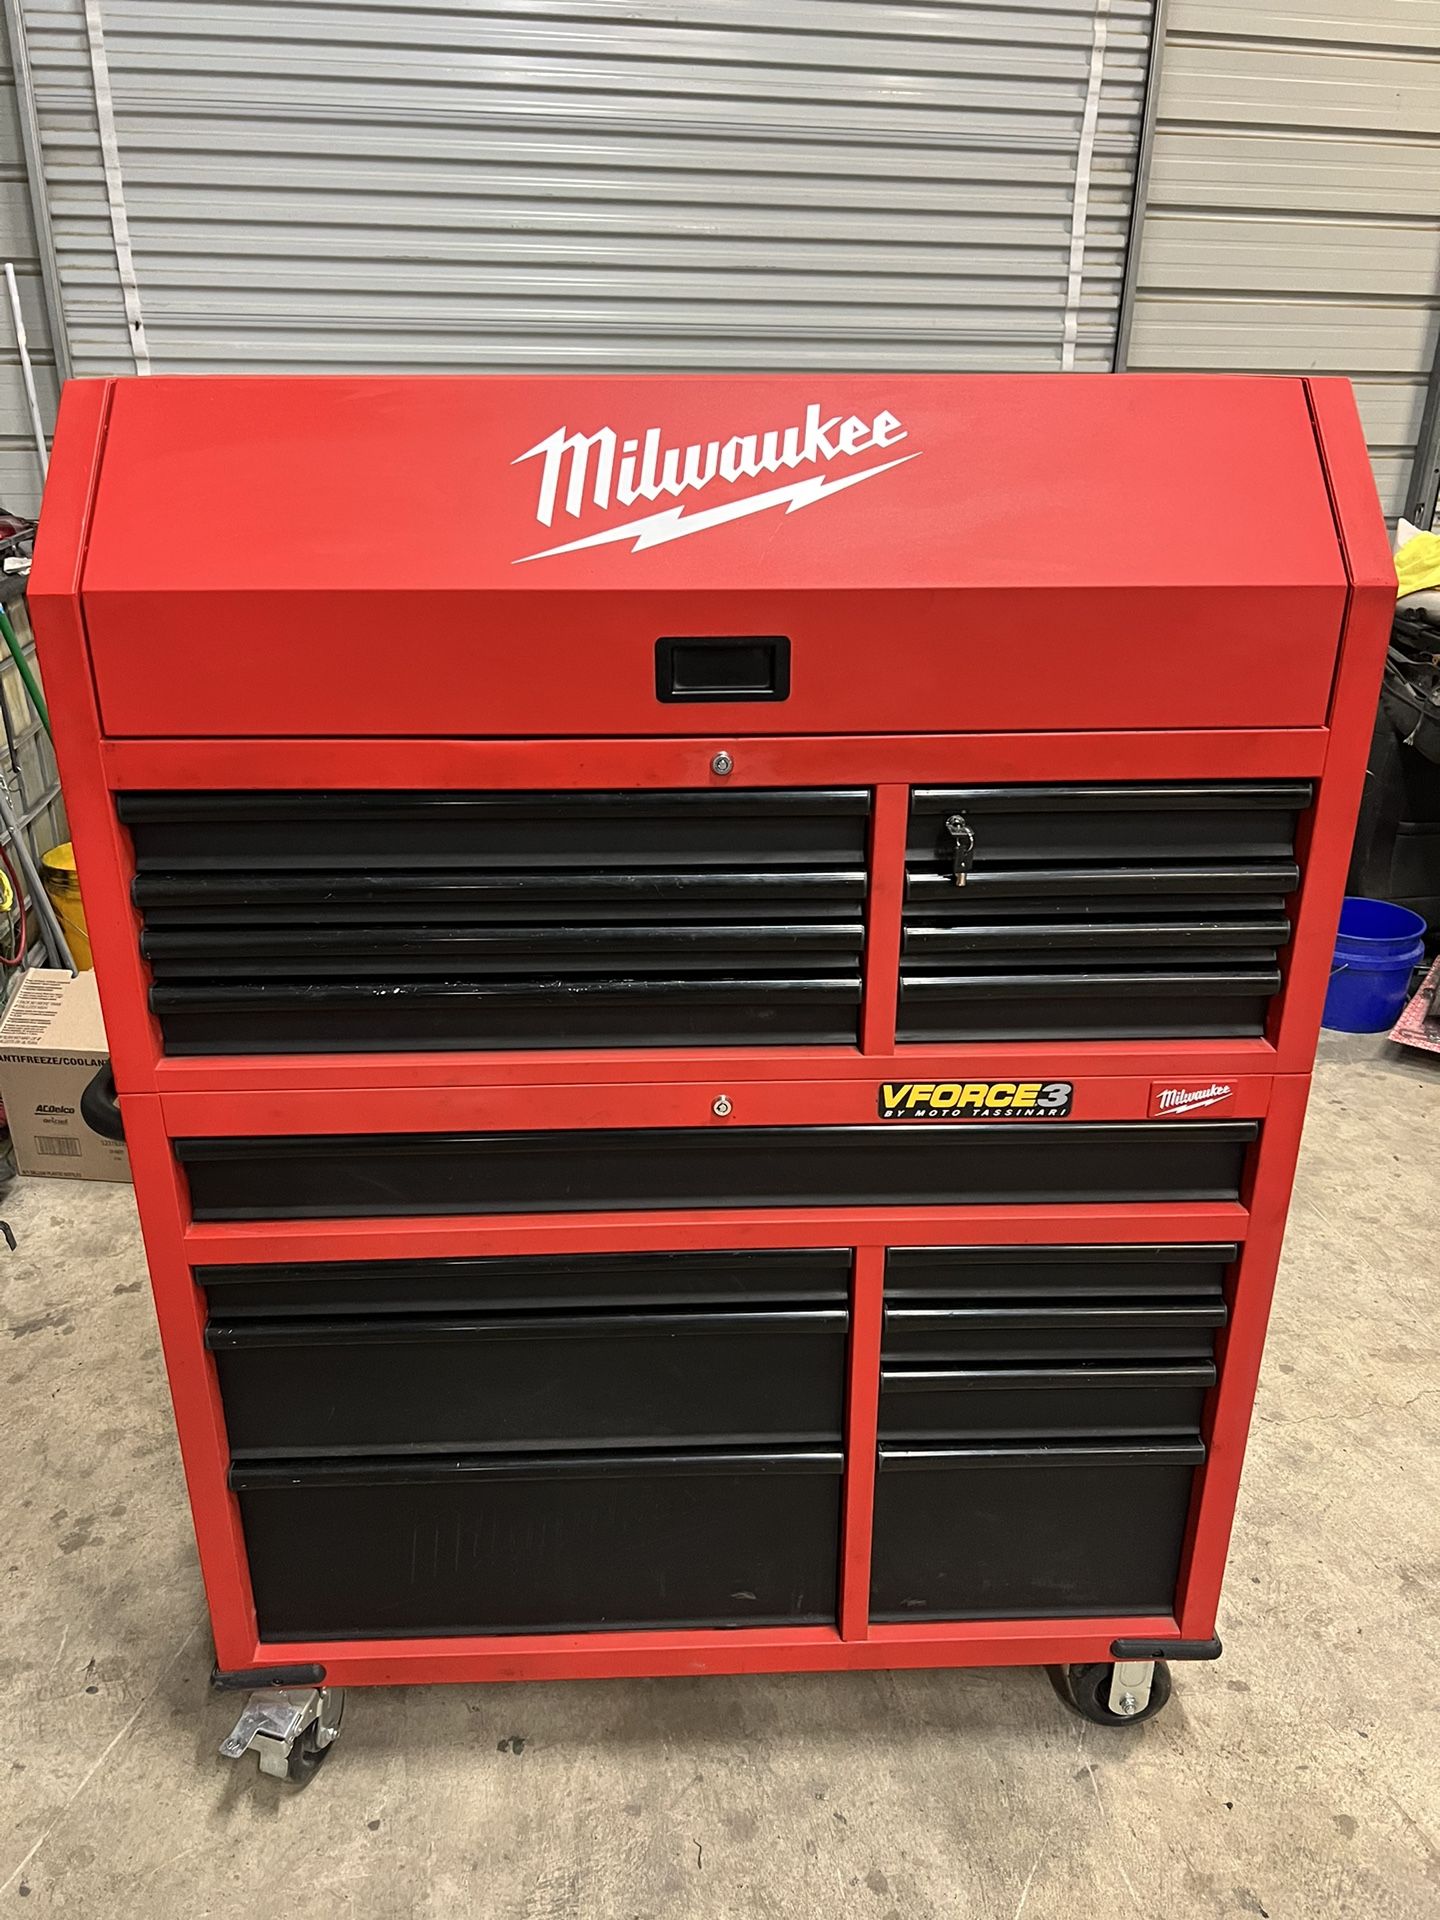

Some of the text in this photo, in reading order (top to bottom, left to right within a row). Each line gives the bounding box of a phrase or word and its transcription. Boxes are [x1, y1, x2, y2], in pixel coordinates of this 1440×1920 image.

[511, 404, 908, 527] Milwaukee
[0, 1054, 106, 1067] ANTIFREEZE/COOLAN
[883, 1083, 1072, 1109] VFORCE3
[1156, 1084, 1232, 1110] Milwaukee
[884, 1109, 1067, 1117] BY MOTO TASSINARI
